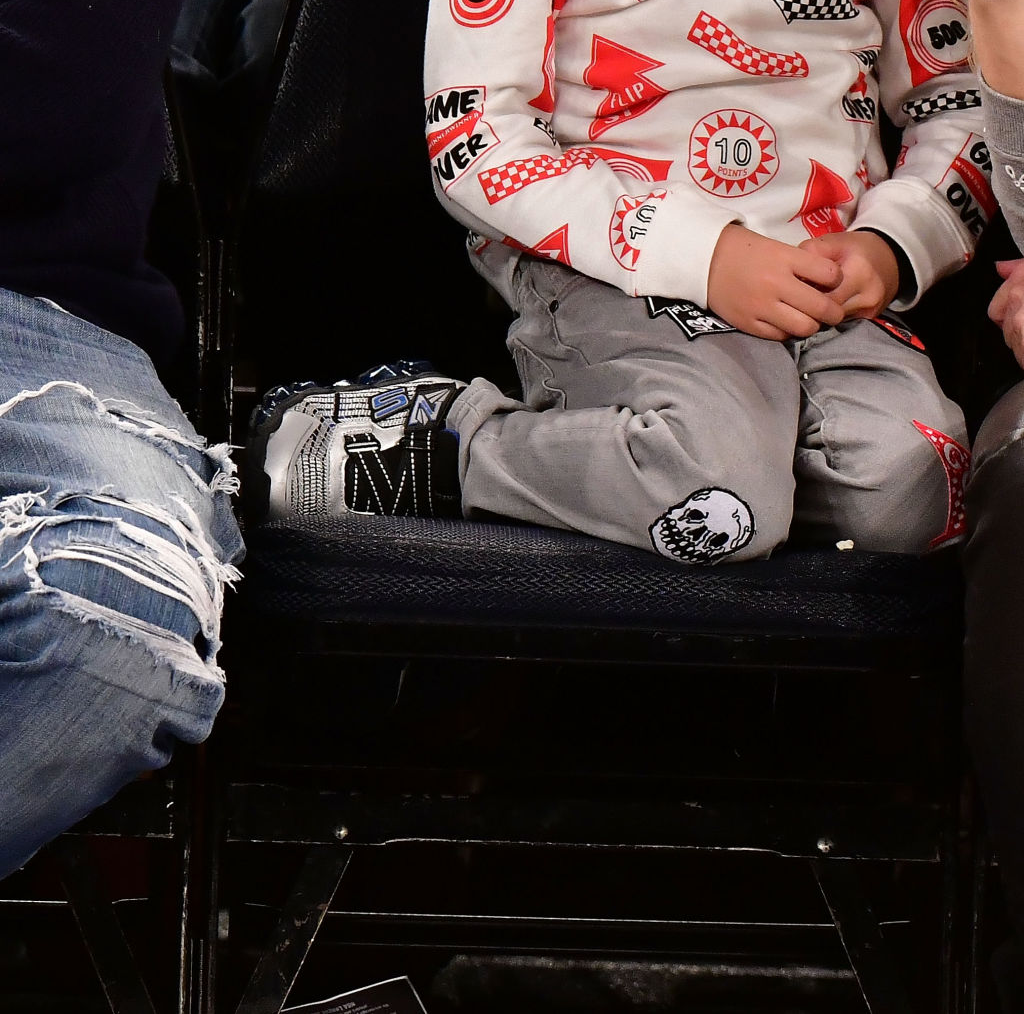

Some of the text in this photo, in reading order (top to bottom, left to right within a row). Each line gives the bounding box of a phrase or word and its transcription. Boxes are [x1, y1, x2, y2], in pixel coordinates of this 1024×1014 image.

[926, 20, 968, 50] 500
[425, 89, 480, 125] AME
[610, 82, 645, 109] FLIP
[433, 133, 489, 181] VER
[715, 137, 752, 167] 10
[718, 166, 748, 178] POINTS
[946, 182, 986, 237] OVE
